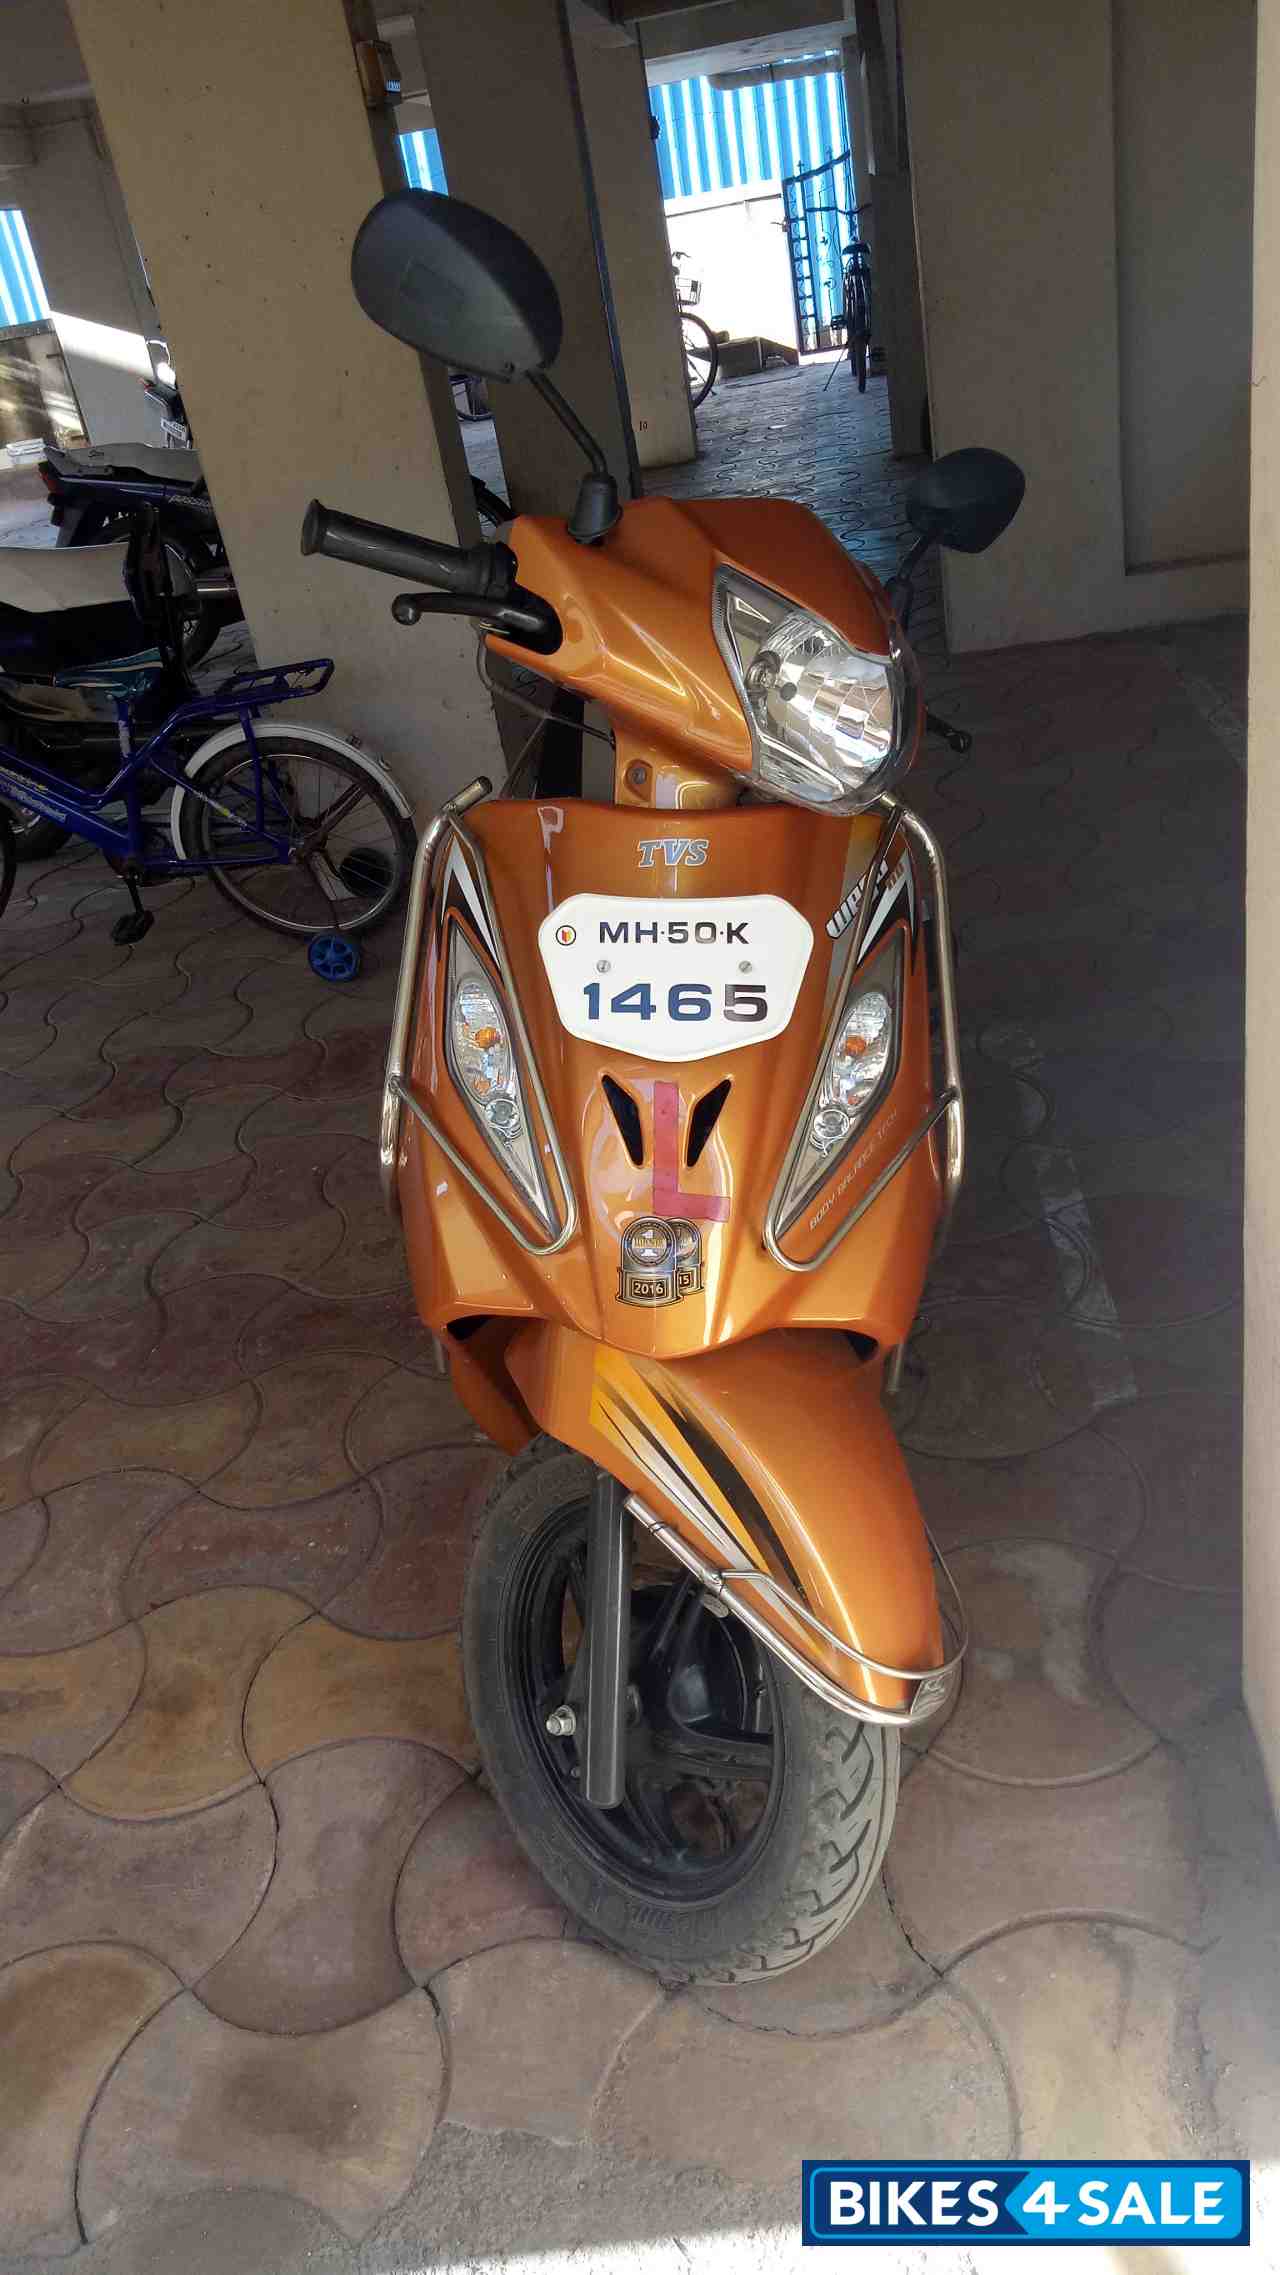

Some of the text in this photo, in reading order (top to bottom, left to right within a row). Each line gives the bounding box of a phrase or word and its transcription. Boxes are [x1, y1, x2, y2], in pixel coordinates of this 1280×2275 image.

[637, 838, 709, 868] TVS
[583, 982, 768, 1022] 1465
[633, 1281, 664, 1295] 2016
